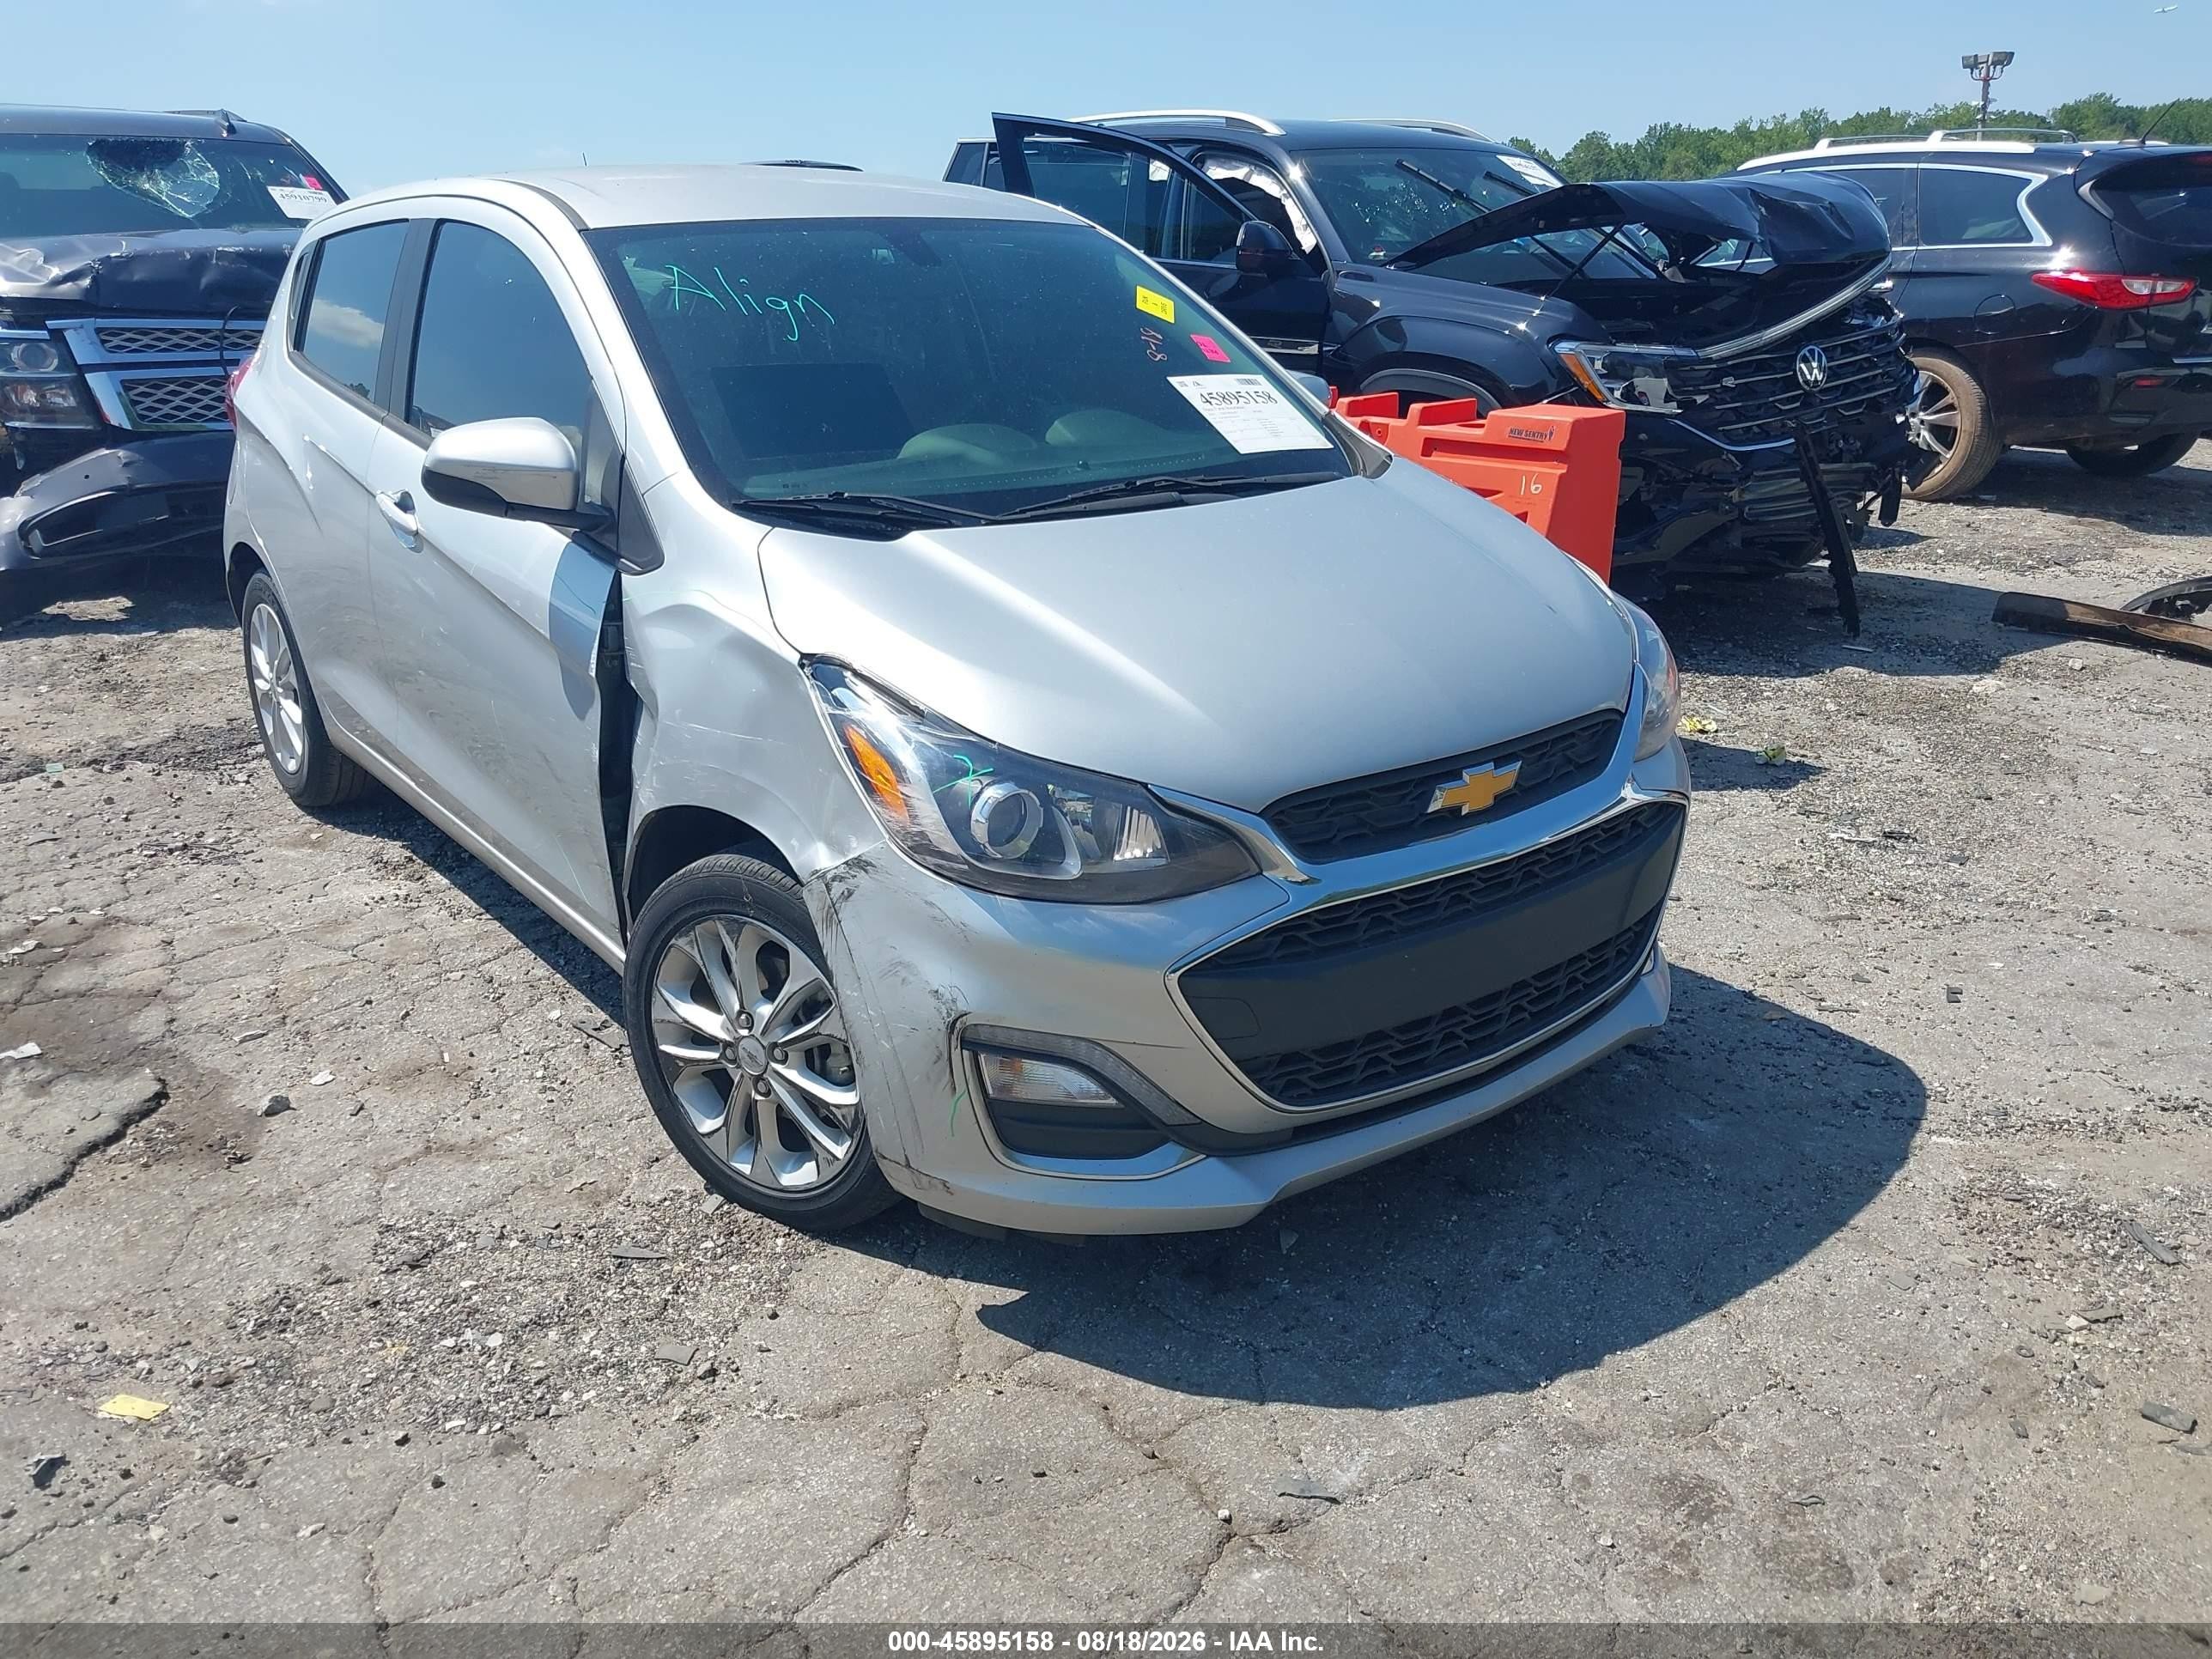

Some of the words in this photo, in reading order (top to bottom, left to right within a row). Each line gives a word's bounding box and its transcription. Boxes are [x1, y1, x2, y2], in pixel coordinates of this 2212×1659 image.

[665, 264, 836, 341] Align
[1200, 391, 1278, 406] 45895158
[1510, 428, 1523, 436] NEW
[1524, 429, 1547, 441] SENTRY
[1520, 473, 1542, 495] 16
